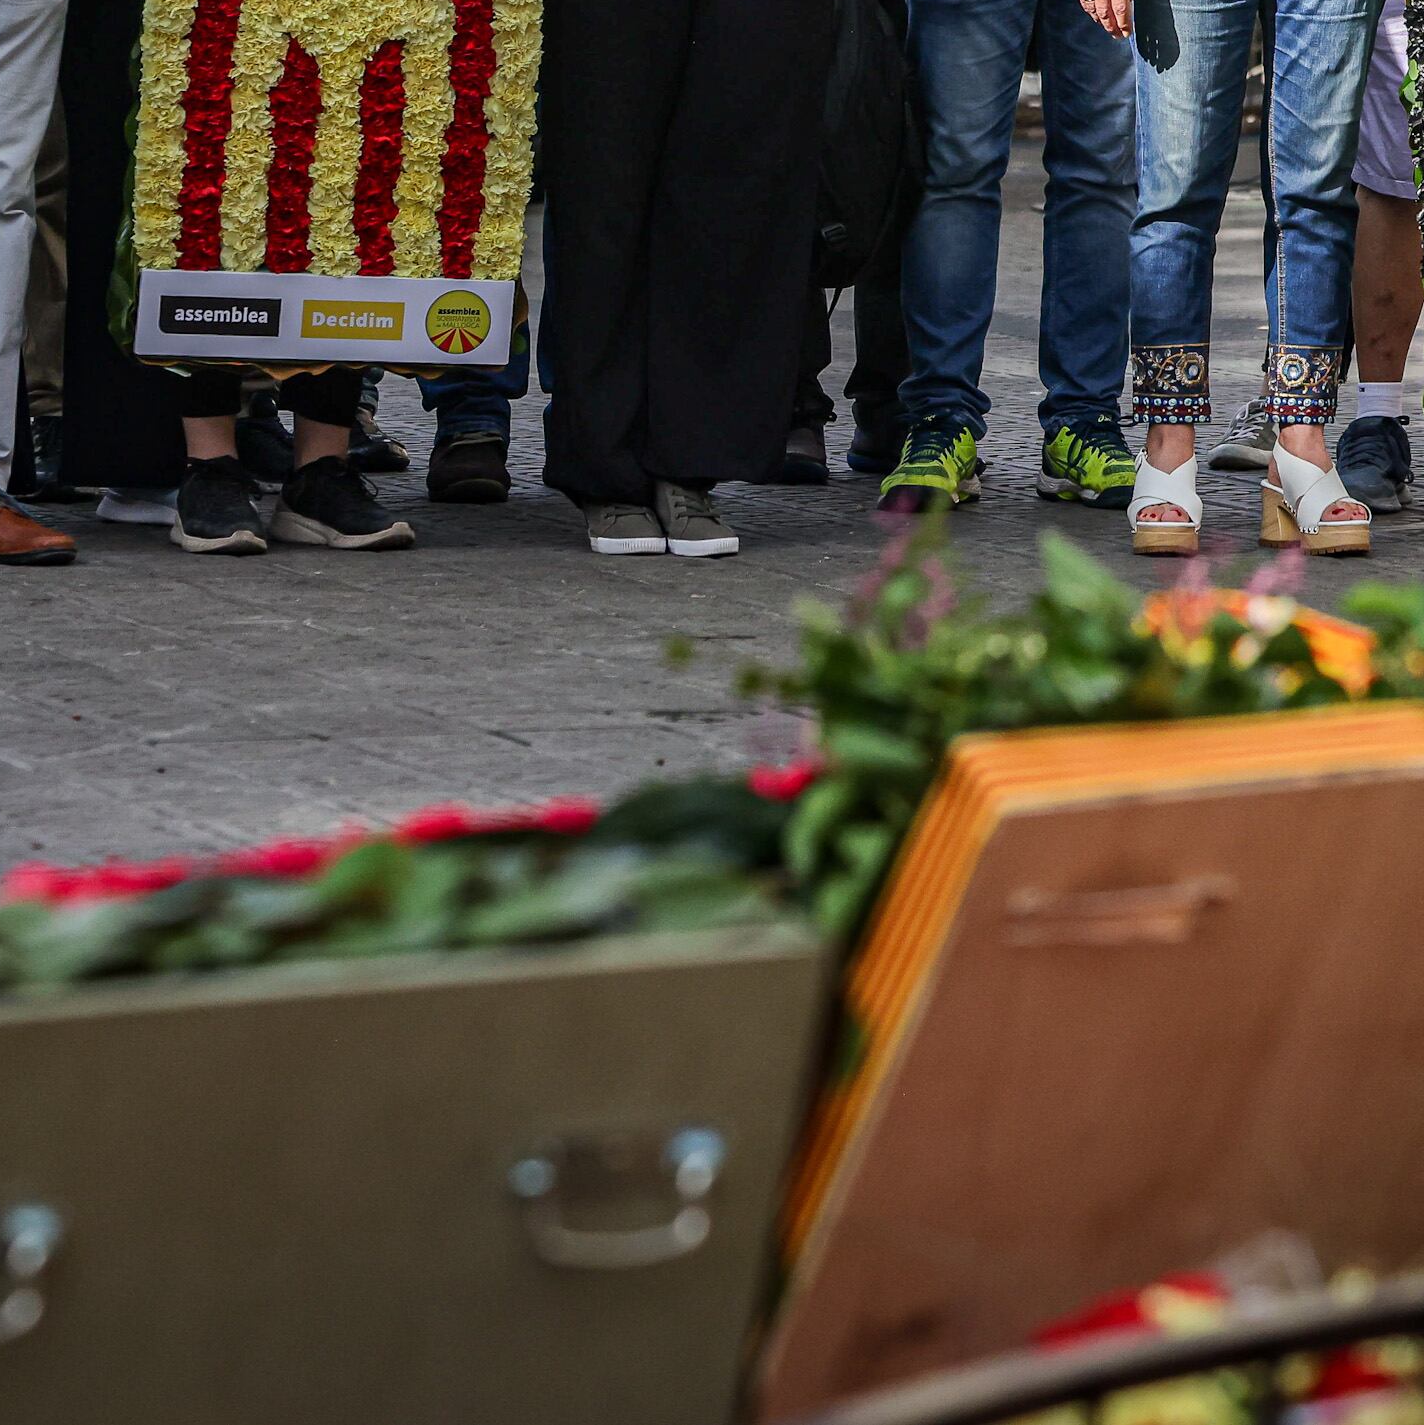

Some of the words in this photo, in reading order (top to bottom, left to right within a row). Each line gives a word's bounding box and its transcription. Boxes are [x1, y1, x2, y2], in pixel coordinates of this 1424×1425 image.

[174, 306, 269, 325] assemblea
[311, 310, 394, 329] Decidim
[437, 307, 481, 316] assemblea
